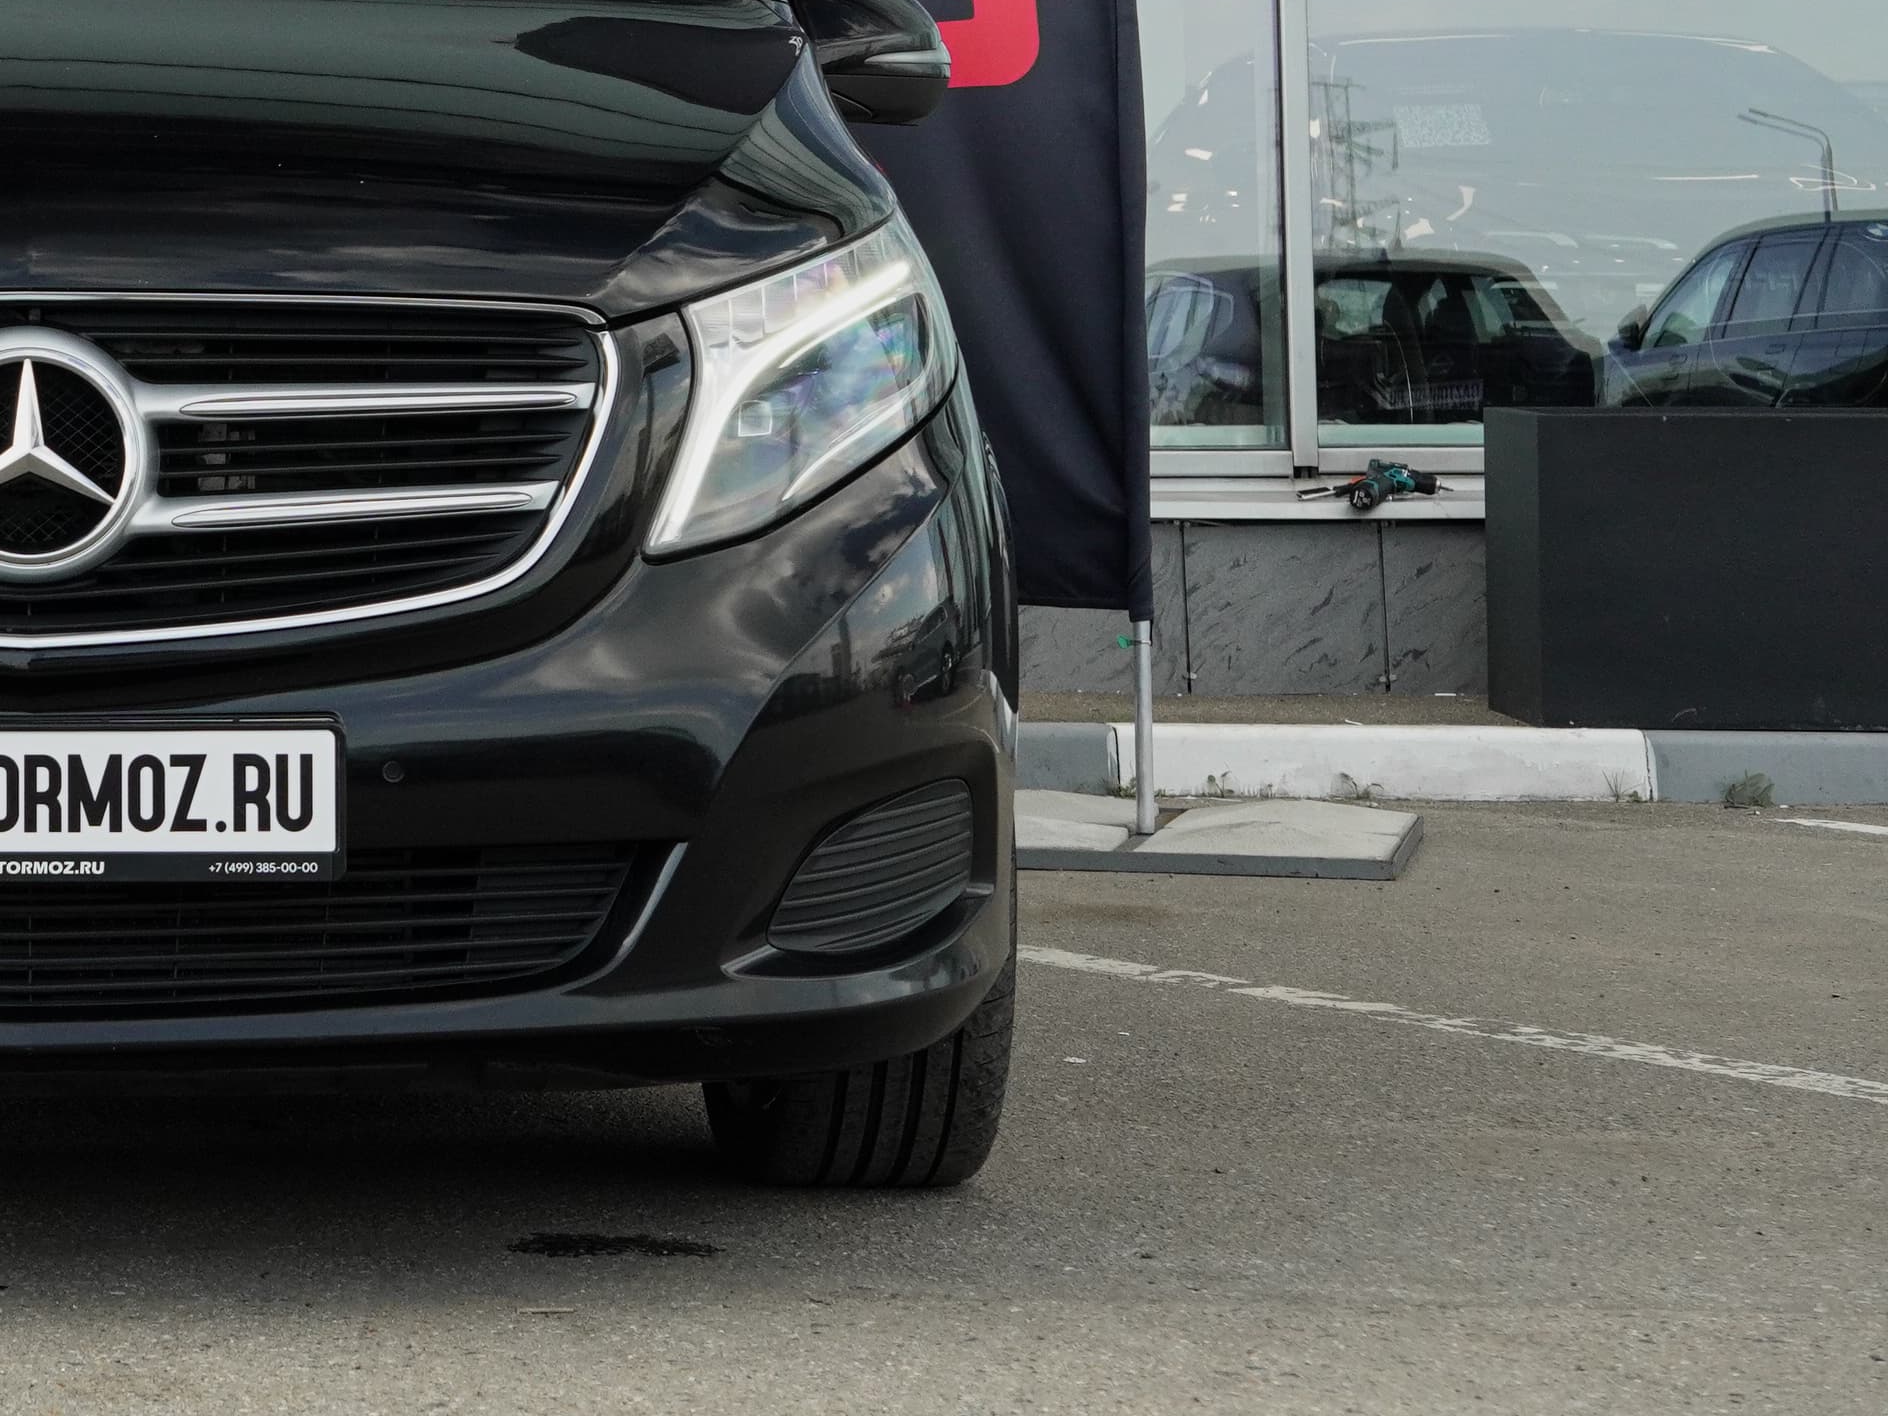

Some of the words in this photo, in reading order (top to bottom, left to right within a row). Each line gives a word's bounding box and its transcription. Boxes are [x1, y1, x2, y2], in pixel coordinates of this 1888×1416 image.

[208, 862, 223, 873] +7
[224, 861, 254, 875] (499)
[255, 862, 319, 874] 385-00-00
